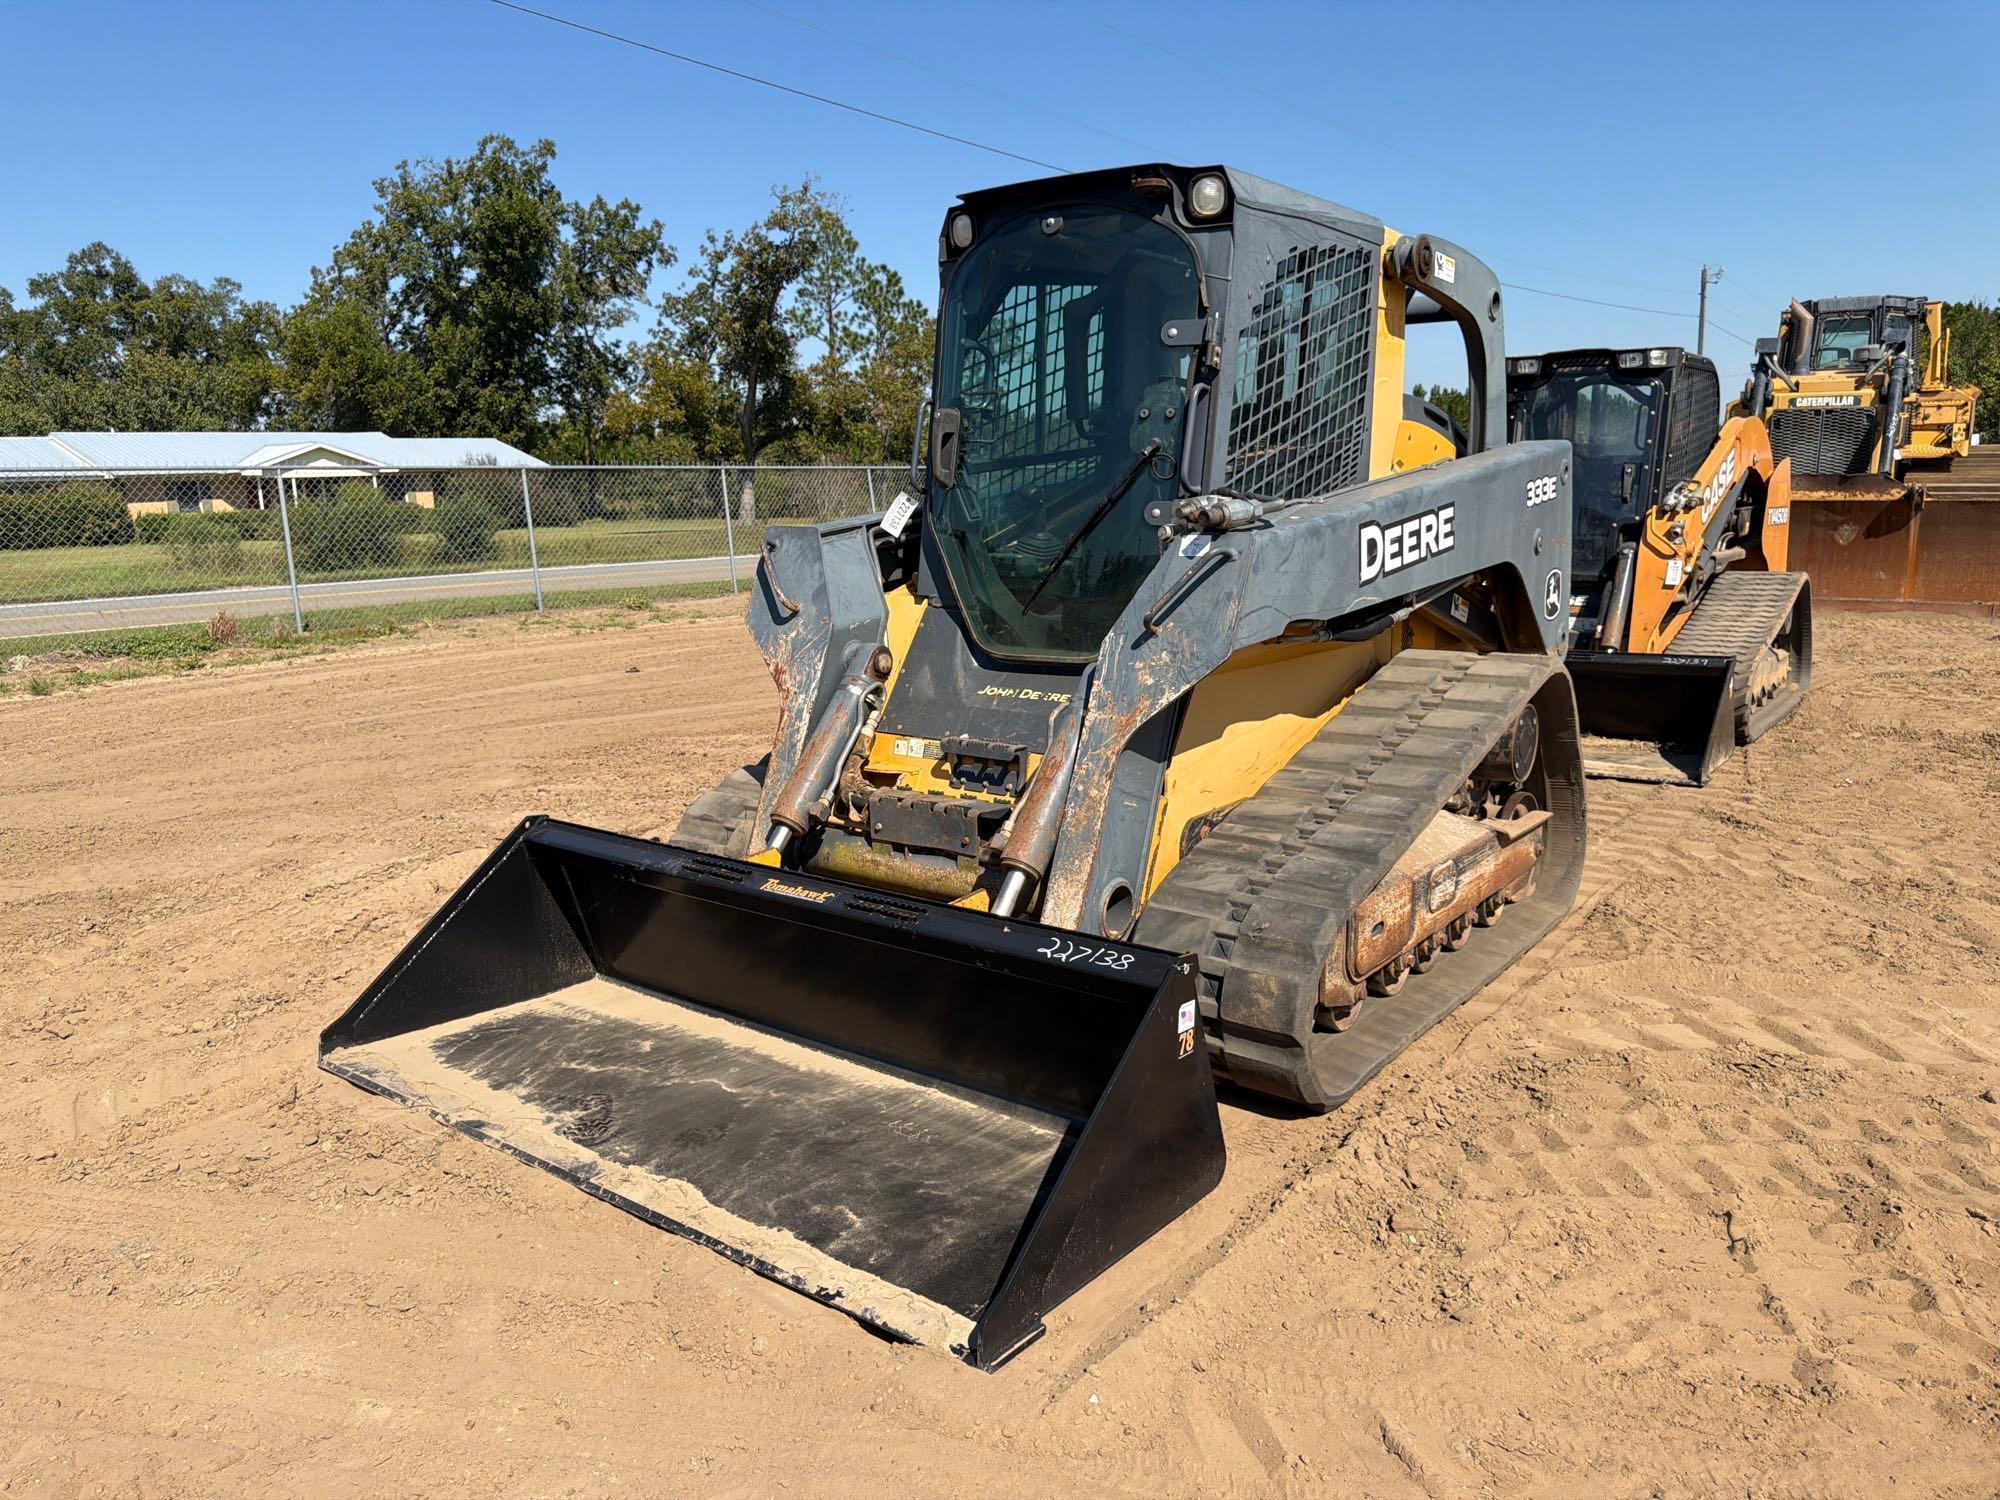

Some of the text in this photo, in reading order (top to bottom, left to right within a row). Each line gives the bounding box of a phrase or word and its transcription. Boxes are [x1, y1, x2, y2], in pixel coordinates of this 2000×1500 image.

[1796, 396, 1854, 407] CATERPILLAR
[1526, 476, 1557, 507] 333E
[1701, 447, 1735, 524] CASE
[889, 502, 911, 530] 227138
[1359, 505, 1455, 585] DEERE
[978, 685, 1020, 698] JOHN
[760, 878, 835, 902] Tomahawk
[1037, 937, 1135, 970] 227138
[1179, 1028, 1194, 1056] 78
